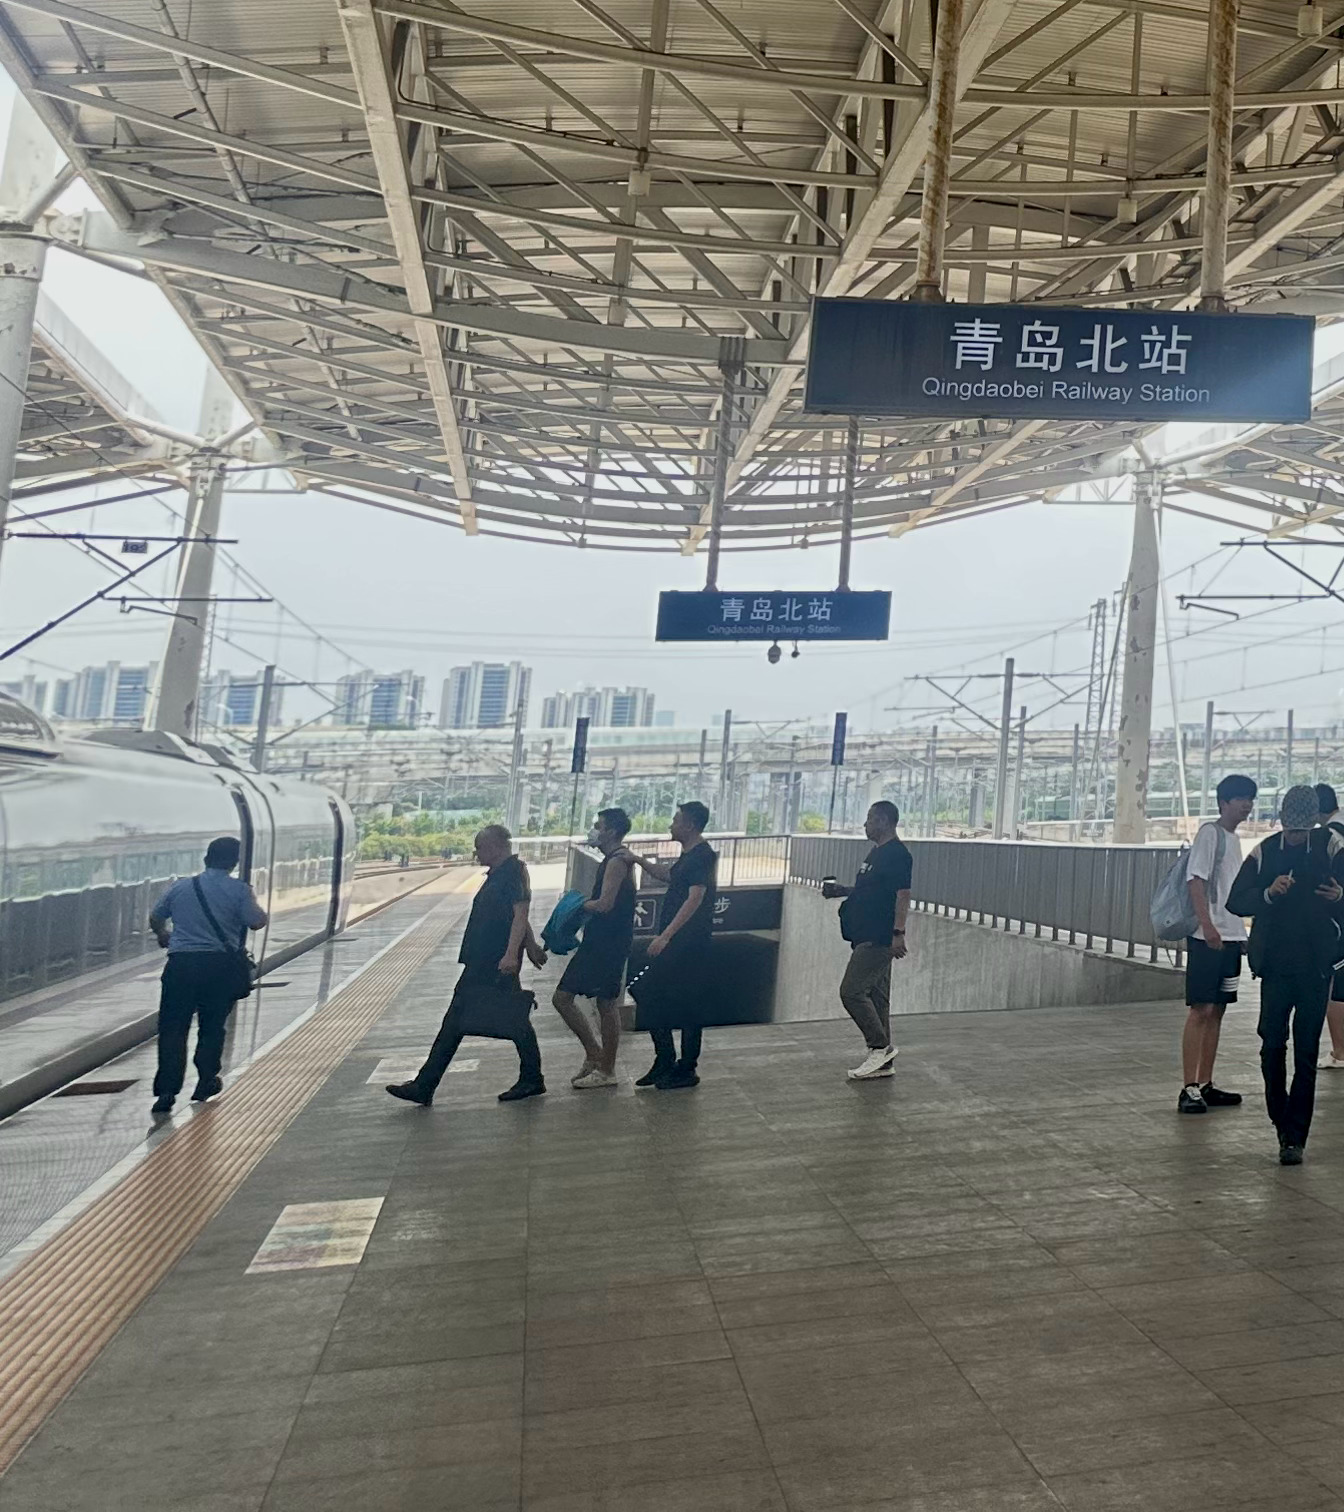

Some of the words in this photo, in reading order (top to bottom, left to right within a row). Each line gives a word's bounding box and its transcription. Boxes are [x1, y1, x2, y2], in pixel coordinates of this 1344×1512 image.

[949, 316, 1194, 375] 青岛北站
[921, 377, 1045, 401] Qingdaobei
[1051, 381, 1133, 405] Railway
[1139, 383, 1211, 403] Station
[720, 597, 834, 622] 青岛北站
